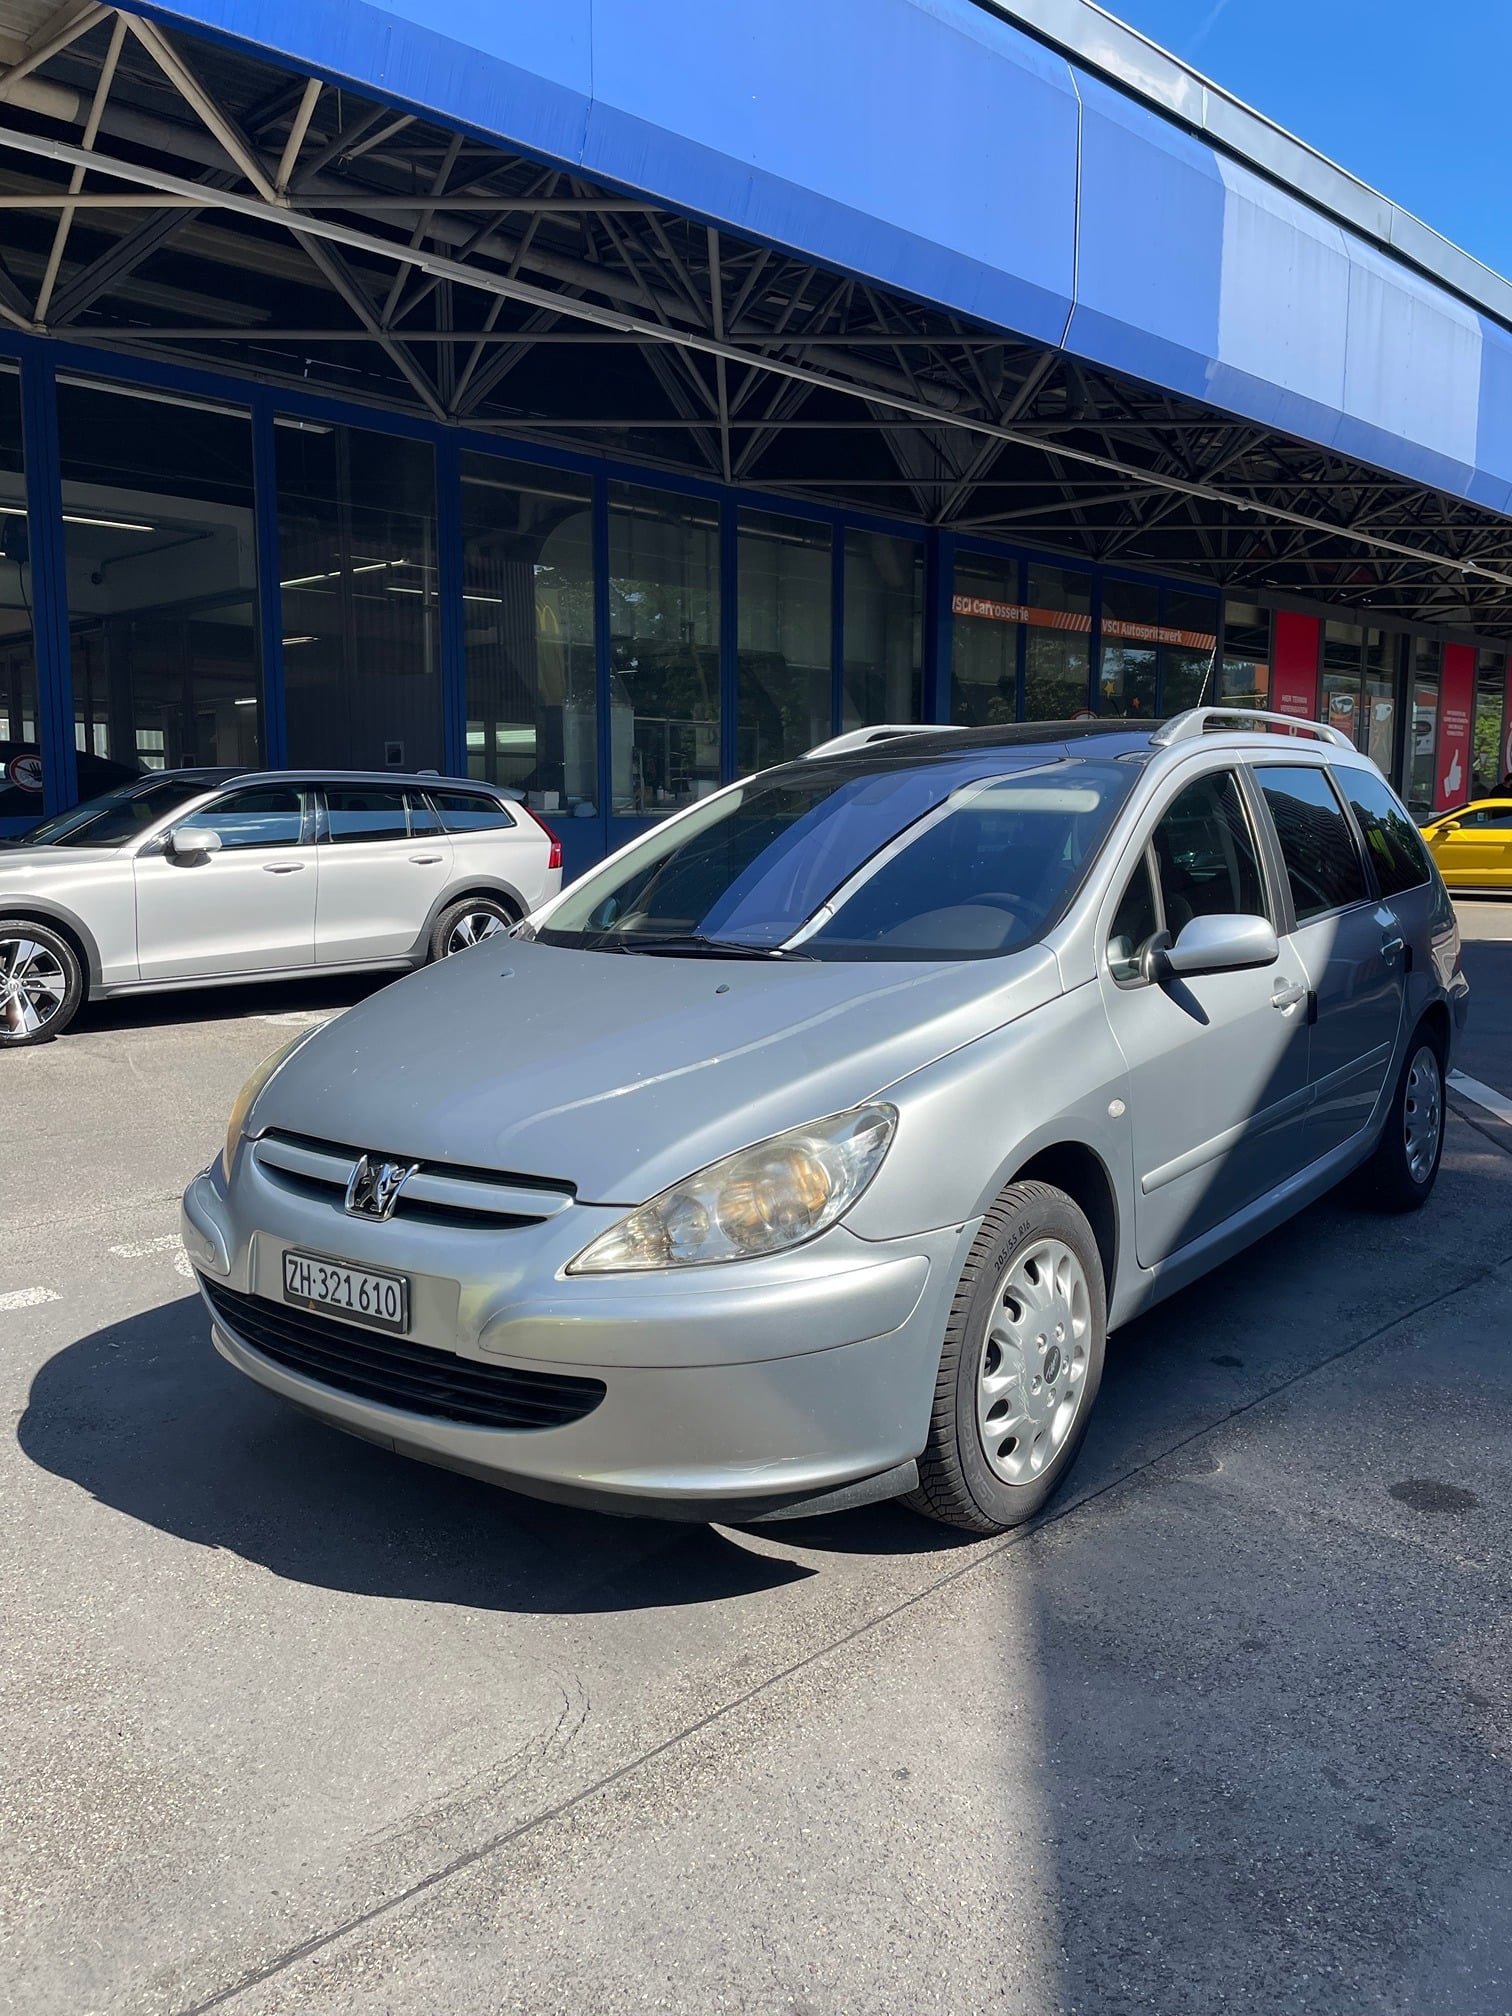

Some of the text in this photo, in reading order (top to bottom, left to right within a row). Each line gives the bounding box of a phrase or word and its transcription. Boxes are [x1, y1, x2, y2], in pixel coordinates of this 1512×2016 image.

[1102, 619, 1183, 642] VSCI Autospritzwerk
[994, 1220, 1031, 1271] 205/55 R16
